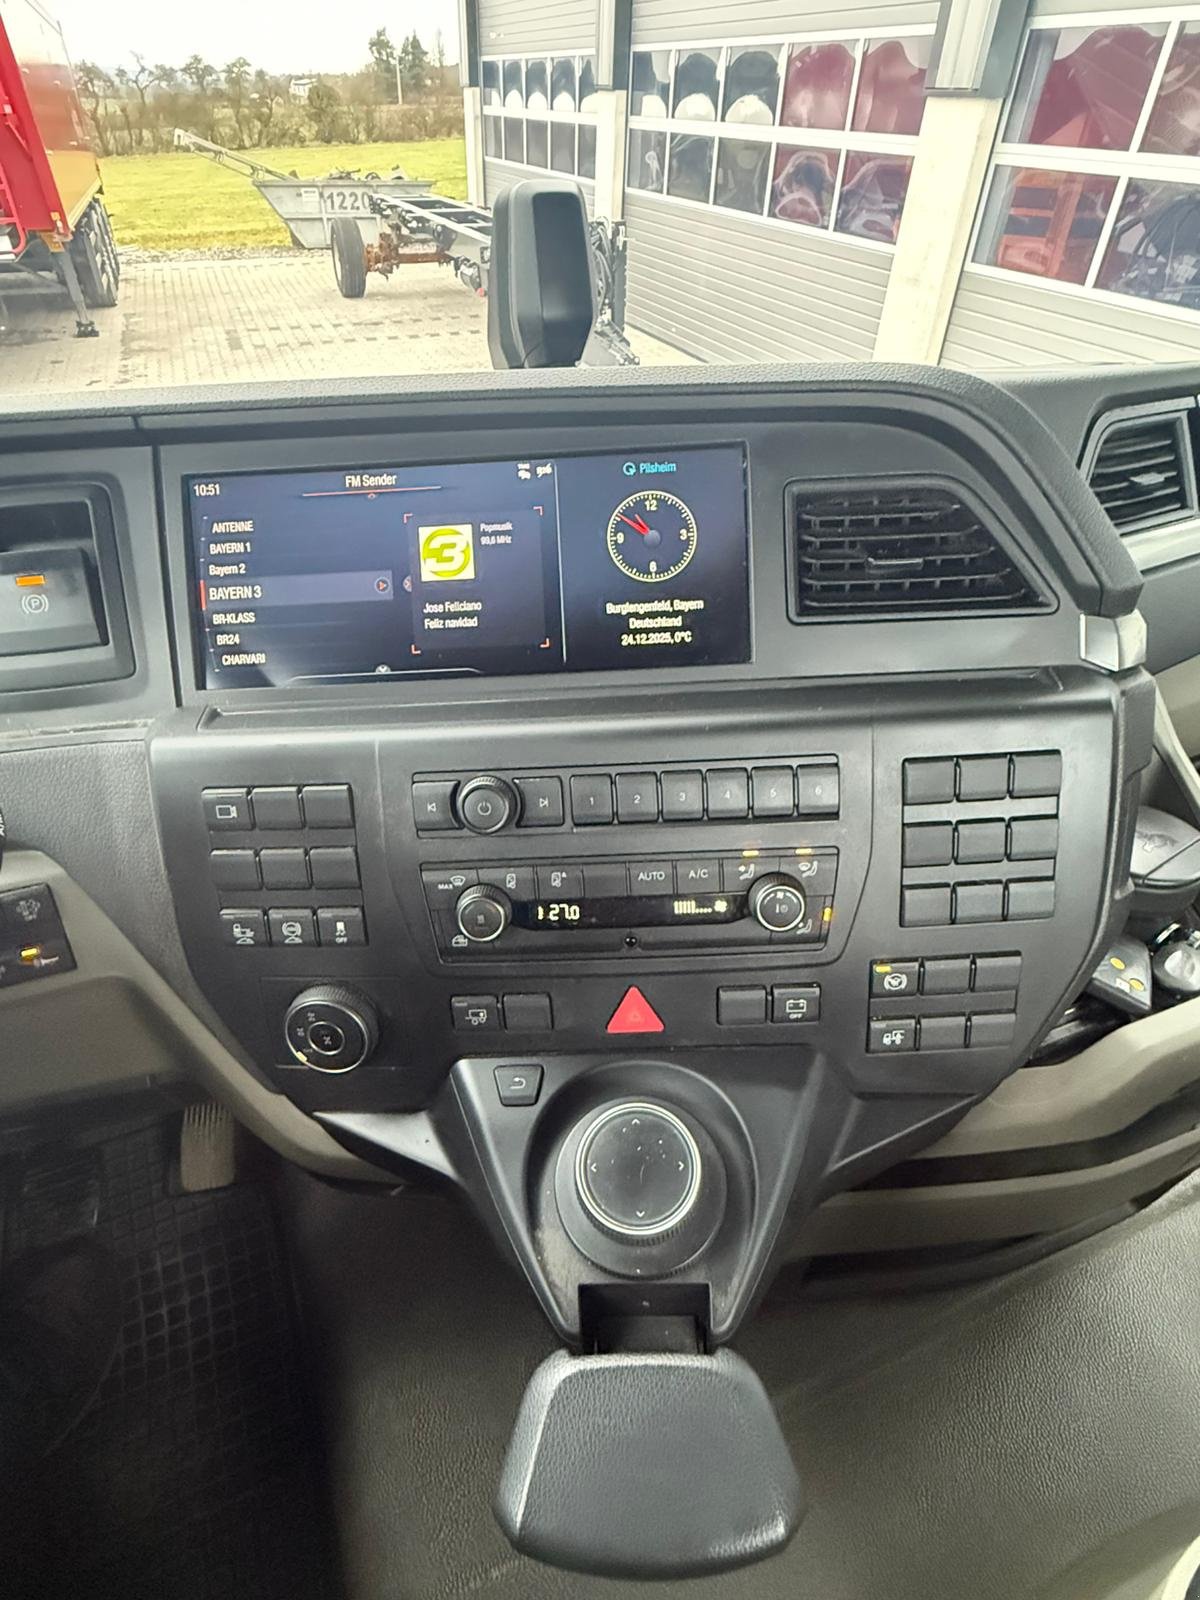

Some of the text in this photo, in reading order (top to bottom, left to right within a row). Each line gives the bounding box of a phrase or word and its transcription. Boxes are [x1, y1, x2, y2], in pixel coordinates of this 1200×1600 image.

[327, 191, 370, 211] 1220
[639, 462, 677, 474] Pilsheim
[345, 474, 397, 487] FM Sender
[193, 484, 220, 496] 10:51
[644, 500, 658, 511] 12
[212, 520, 254, 534] ANTENNE
[616, 533, 625, 544] 9
[679, 529, 688, 541] 3
[210, 541, 251, 555] BAYERN 1
[208, 563, 246, 577] Bayern 2
[649, 561, 657, 572] 6
[209, 585, 262, 600] BAYERN 3
[423, 601, 482, 614] Jose Feliciano
[605, 599, 704, 615] Burglengenfeld, Bayern
[212, 612, 256, 625] BR-KLASS
[424, 617, 478, 630] Feliz navidad
[629, 616, 682, 629] Deutschland
[216, 634, 240, 645] BR24
[621, 632, 674, 646] 24.12.2025,
[222, 653, 266, 666] CHARVARI
[679, 792, 686, 801] 3
[724, 790, 731, 799] 4
[815, 786, 822, 796] 6
[634, 795, 641, 804] 2
[638, 871, 665, 881] AUTO
[688, 868, 709, 879] A/C
